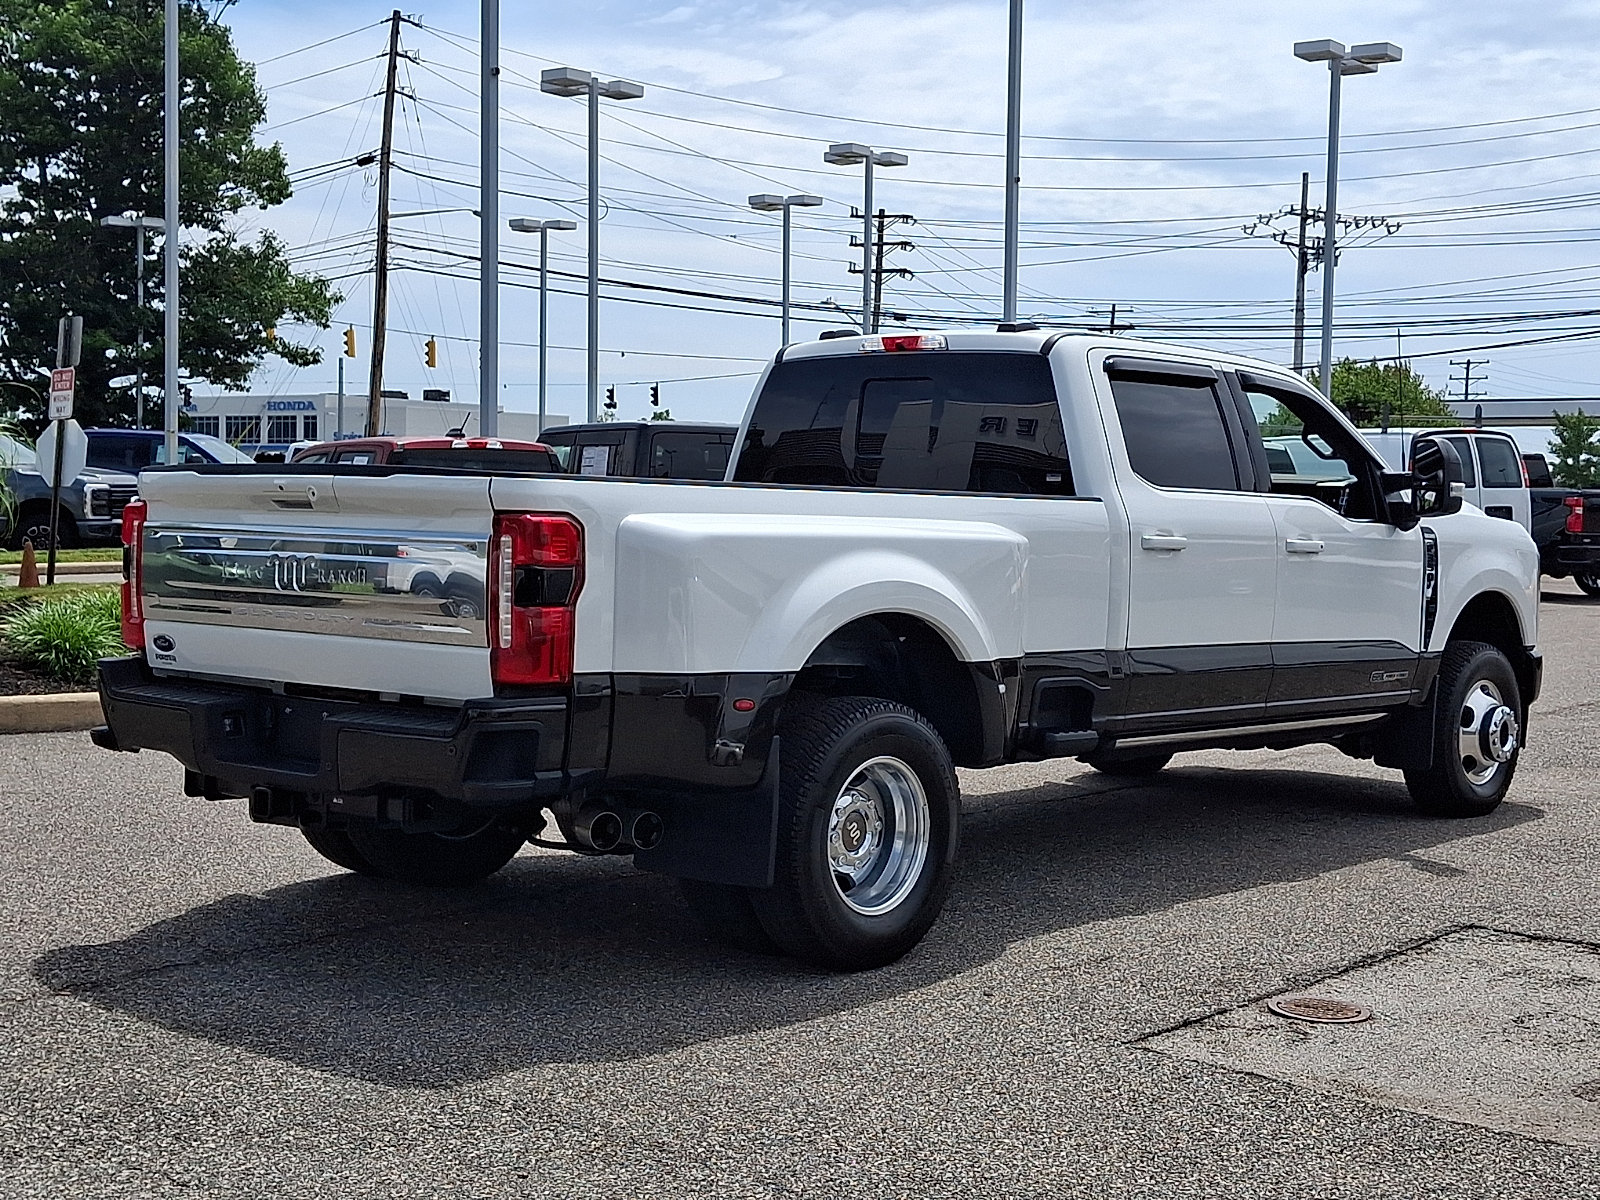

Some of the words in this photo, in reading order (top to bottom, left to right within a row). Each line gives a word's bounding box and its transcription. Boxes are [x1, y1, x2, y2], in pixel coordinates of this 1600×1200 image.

[54, 373, 61, 381] DO
[62, 372, 71, 381] NOT
[54, 382, 70, 390] ENTER
[267, 401, 316, 411] HONDA
[333, 431, 363, 441] Srvice
[317, 568, 366, 585] RANCH
[233, 607, 298, 620] SUPER
[304, 612, 354, 622] DUTY
